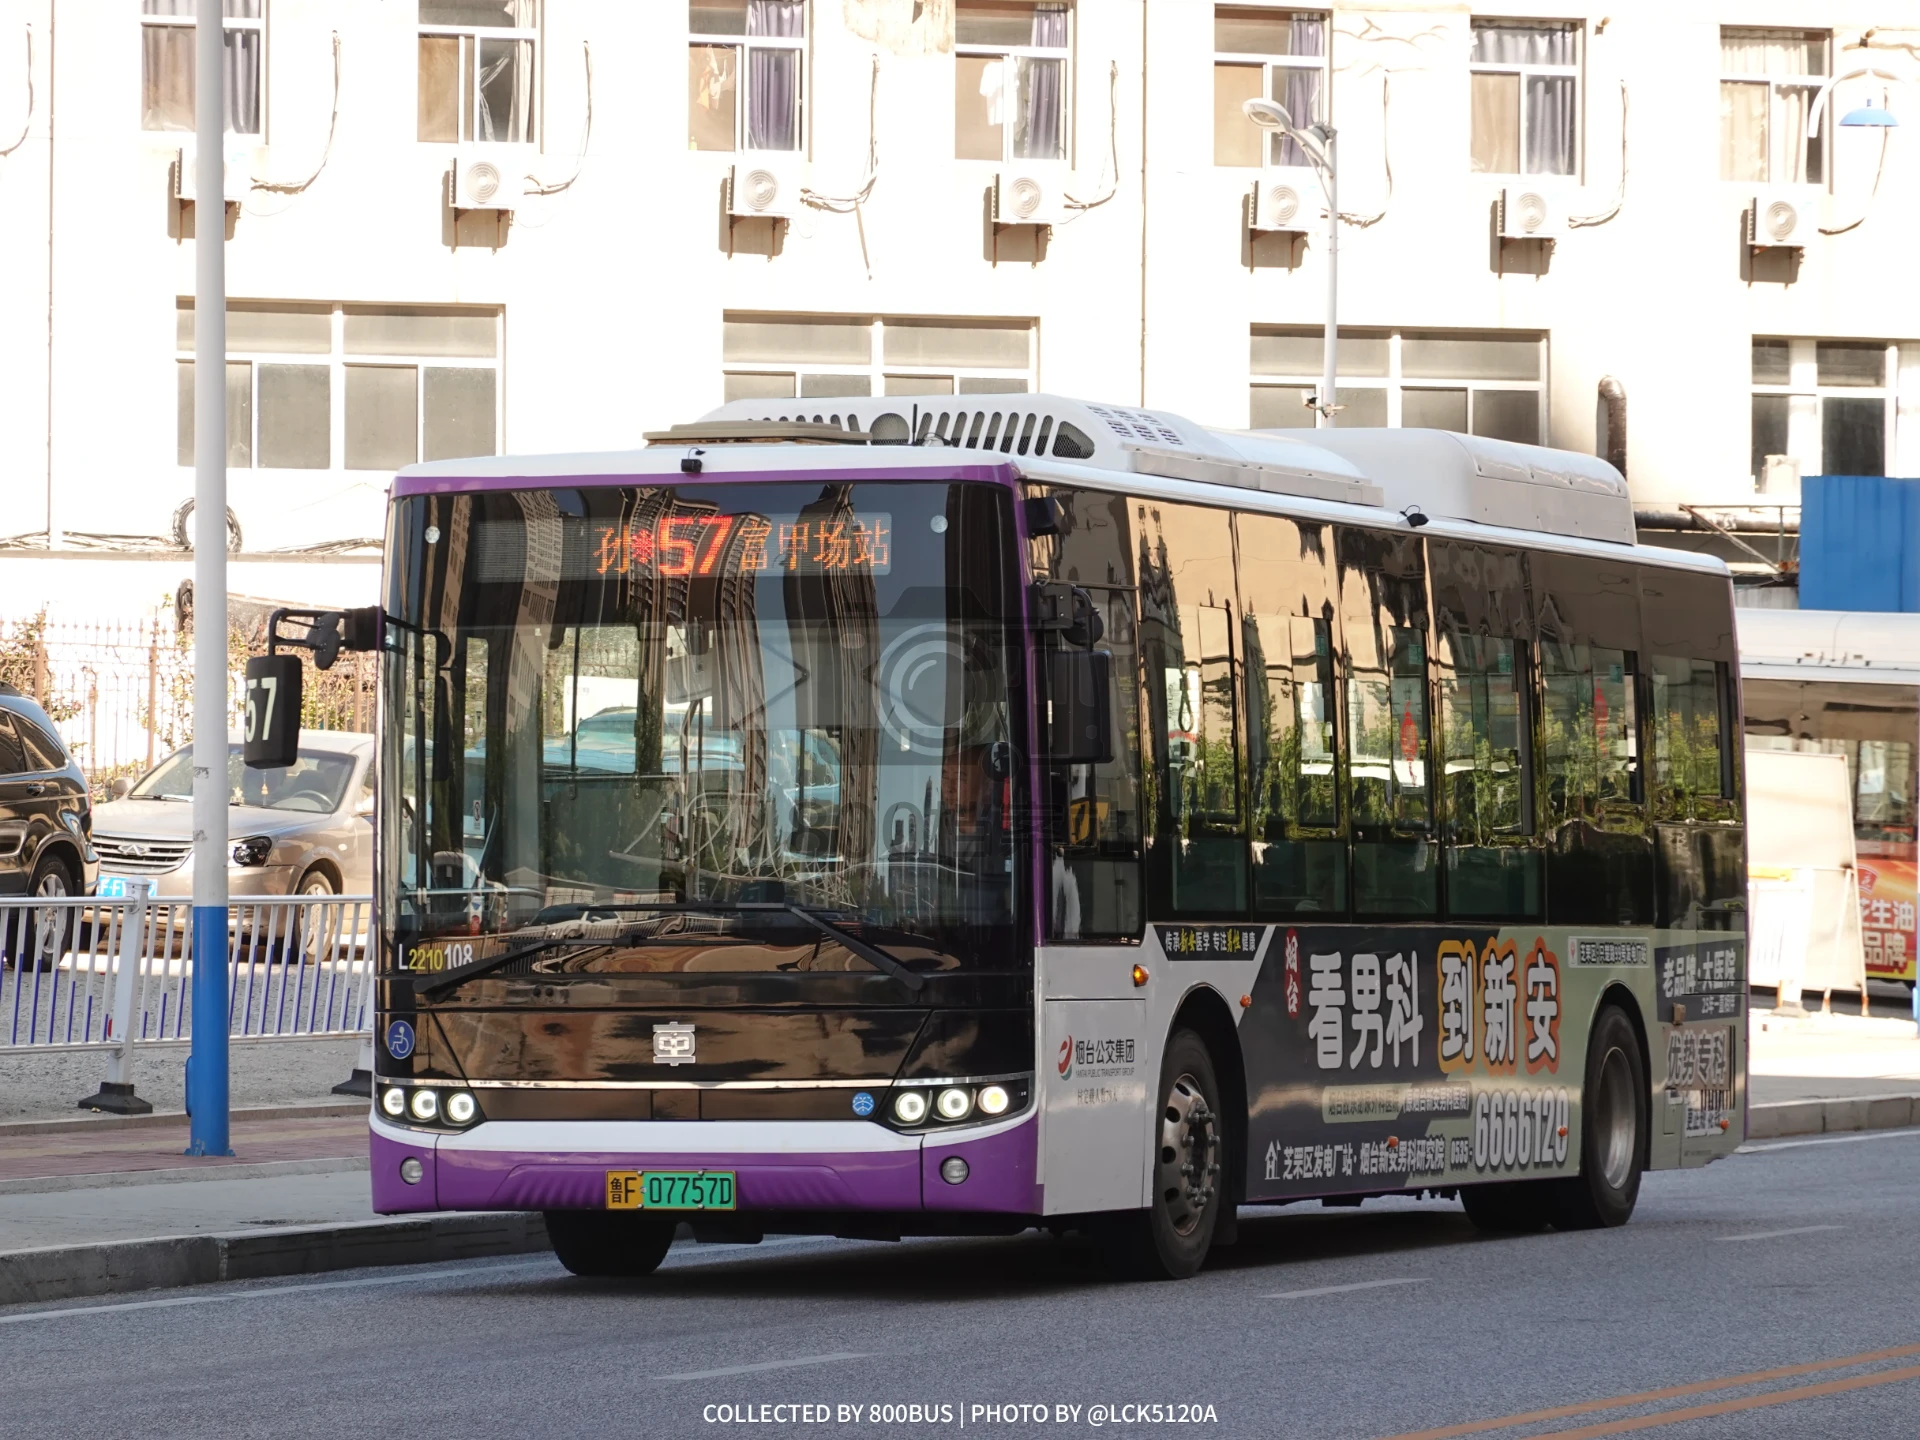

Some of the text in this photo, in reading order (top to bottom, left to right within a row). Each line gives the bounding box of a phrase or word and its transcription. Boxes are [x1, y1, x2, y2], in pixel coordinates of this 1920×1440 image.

[658, 515, 733, 576] 57
[738, 518, 890, 571] 富甲场站
[244, 677, 277, 742] 57
[398, 943, 473, 970] L2210108
[1285, 936, 1299, 1014] 烟台
[1075, 1039, 1135, 1065] 烟台公交集团
[1667, 1029, 1727, 1087] 优势专科
